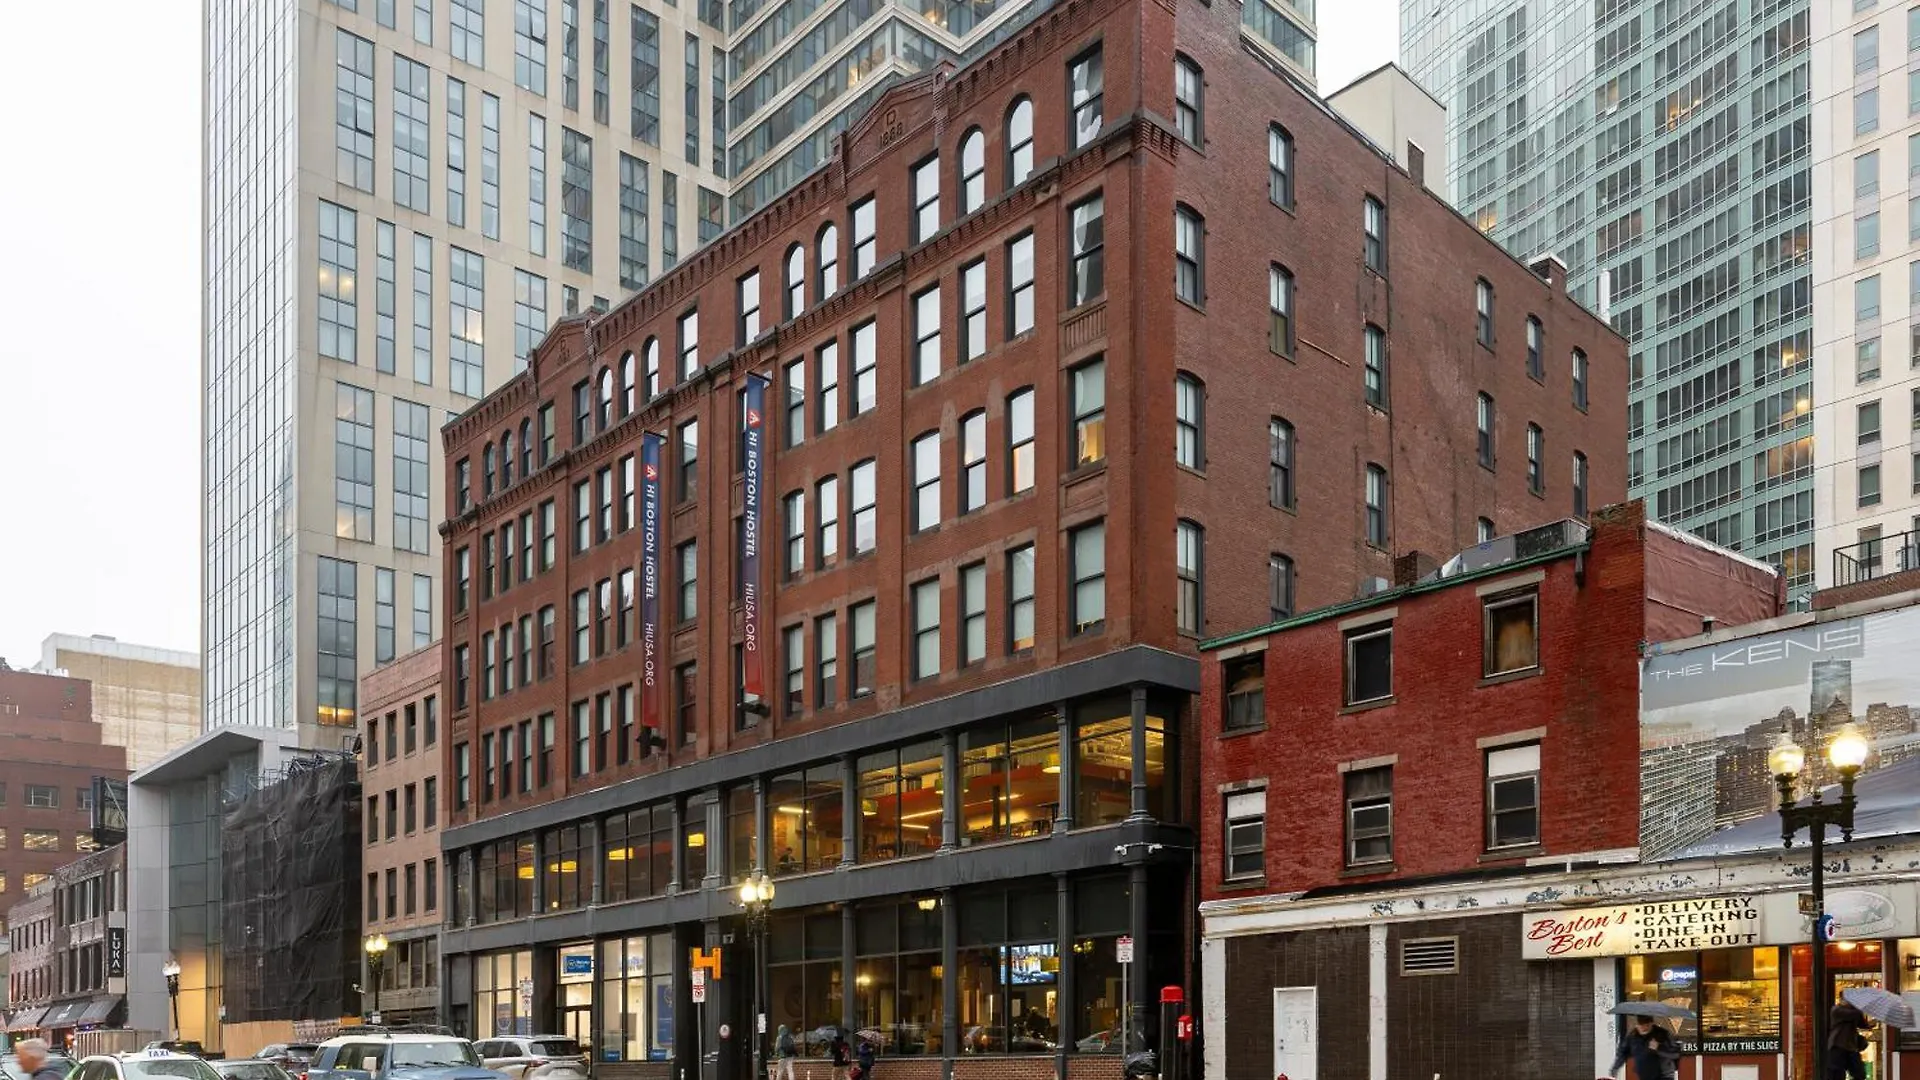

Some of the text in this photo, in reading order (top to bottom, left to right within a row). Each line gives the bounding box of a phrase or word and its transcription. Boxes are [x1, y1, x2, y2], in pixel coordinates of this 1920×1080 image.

[745, 431, 757, 557] HI BOSTON HOSTEL
[645, 485, 655, 600] HI BOSTON HOSTEL
[745, 583, 756, 651] HIUSA.ORG
[645, 622, 654, 686] HIUSA.ORG
[1650, 625, 1861, 682] THE KENS
[1643, 897, 1752, 916] DELIVERY
[1643, 908, 1758, 927] CATERING
[1526, 909, 1628, 940] Boston's
[1643, 923, 1726, 939] DINE-IN
[112, 931, 120, 968] LUKA
[1546, 931, 1604, 955] Best
[1643, 933, 1757, 950] TAKE-OUT
[148, 1050, 169, 1058] TAXI
[1703, 1042, 1726, 1051] PIZZA
[1728, 1042, 1737, 1051] BY
[1740, 1041, 1755, 1050] THE
[1757, 1040, 1779, 1050] SLICE
